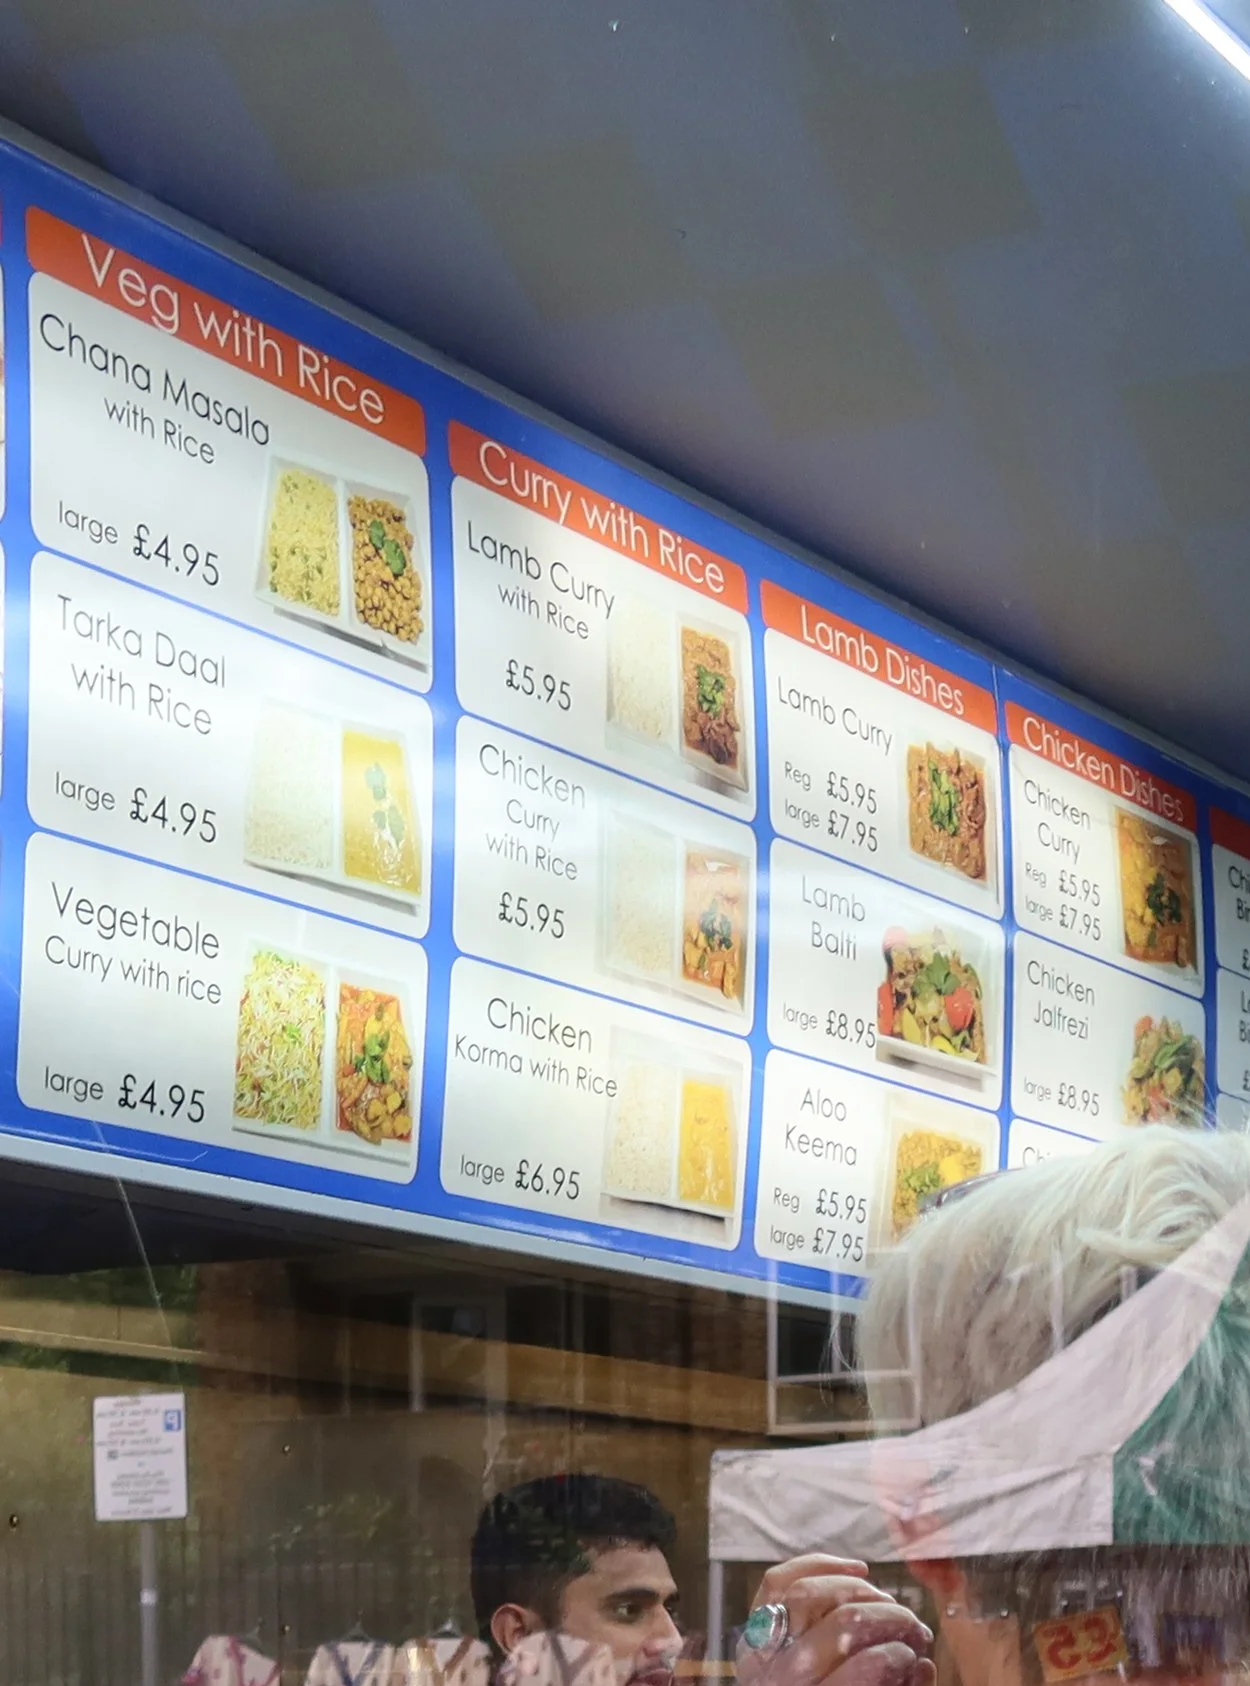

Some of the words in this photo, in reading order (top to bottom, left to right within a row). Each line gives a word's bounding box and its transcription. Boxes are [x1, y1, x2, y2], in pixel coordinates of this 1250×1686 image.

[82, 233, 180, 335] Veg
[194, 302, 283, 377] with
[298, 345, 386, 425] Rice
[39, 313, 151, 394] Chana
[164, 369, 270, 445] Masala
[104, 397, 155, 439] with
[165, 420, 215, 464] Rice
[58, 500, 118, 545] large
[133, 524, 219, 586] £4.95
[479, 441, 572, 525] Curry
[581, 498, 649, 558] with
[659, 528, 724, 593] Rice
[468, 521, 541, 581] Lamb
[550, 562, 615, 619] Curry
[498, 584, 540, 619] with
[547, 601, 589, 639] Rice
[57, 595, 143, 658] Tarka
[156, 633, 226, 688] Daal
[801, 605, 879, 673] Lamb
[886, 648, 964, 716] Dishes
[70, 662, 136, 710] with
[149, 683, 212, 735] Rice
[506, 659, 571, 711] £5.95
[778, 676, 835, 725] Lamb
[842, 708, 892, 755] Curry
[479, 743, 585, 808] Chicken
[785, 761, 811, 791] Reg
[827, 771, 877, 814] £5.95
[1023, 717, 1115, 788] Chicken
[1120, 764, 1184, 821] Dishes
[55, 771, 115, 811] large
[129, 787, 217, 844] £4.95
[506, 799, 560, 841] Curry
[785, 799, 820, 828] large
[828, 810, 878, 852] £7.95
[1024, 779, 1091, 830] Chicken
[485, 831, 528, 866] with
[535, 844, 577, 880] Rice
[1038, 822, 1080, 865] Curry
[801, 875, 866, 923] Lamb
[1025, 862, 1046, 888] Reg
[1059, 869, 1100, 907] £5.95
[51, 882, 220, 959] Vegetable
[498, 892, 564, 939] £5.95
[811, 922, 857, 961] Balti
[1025, 895, 1053, 920] large
[1059, 903, 1100, 941] £7.95
[45, 935, 114, 981] Curry
[120, 959, 170, 993] with
[177, 973, 221, 1004] rice
[1027, 960, 1094, 1006] Chicken
[487, 997, 592, 1053] Chicken
[782, 1002, 818, 1031] large
[825, 1009, 875, 1049] £8.95
[1033, 1000, 1088, 1040] Jalfrezi
[454, 1034, 523, 1075] Korma
[529, 1057, 570, 1087] with
[576, 1068, 617, 1097] Rice
[44, 1066, 104, 1102] large
[117, 1074, 205, 1124] £4.95
[800, 1087, 846, 1122] Aloo
[1024, 1076, 1051, 1101] large
[1058, 1082, 1099, 1116] £8.95
[785, 1124, 857, 1166] Keema
[460, 1155, 504, 1186] large
[515, 1159, 579, 1200] £6.95
[773, 1187, 800, 1213] Reg
[815, 1189, 866, 1224] £5.95
[770, 1225, 804, 1250] large
[812, 1228, 863, 1263] £7.95
